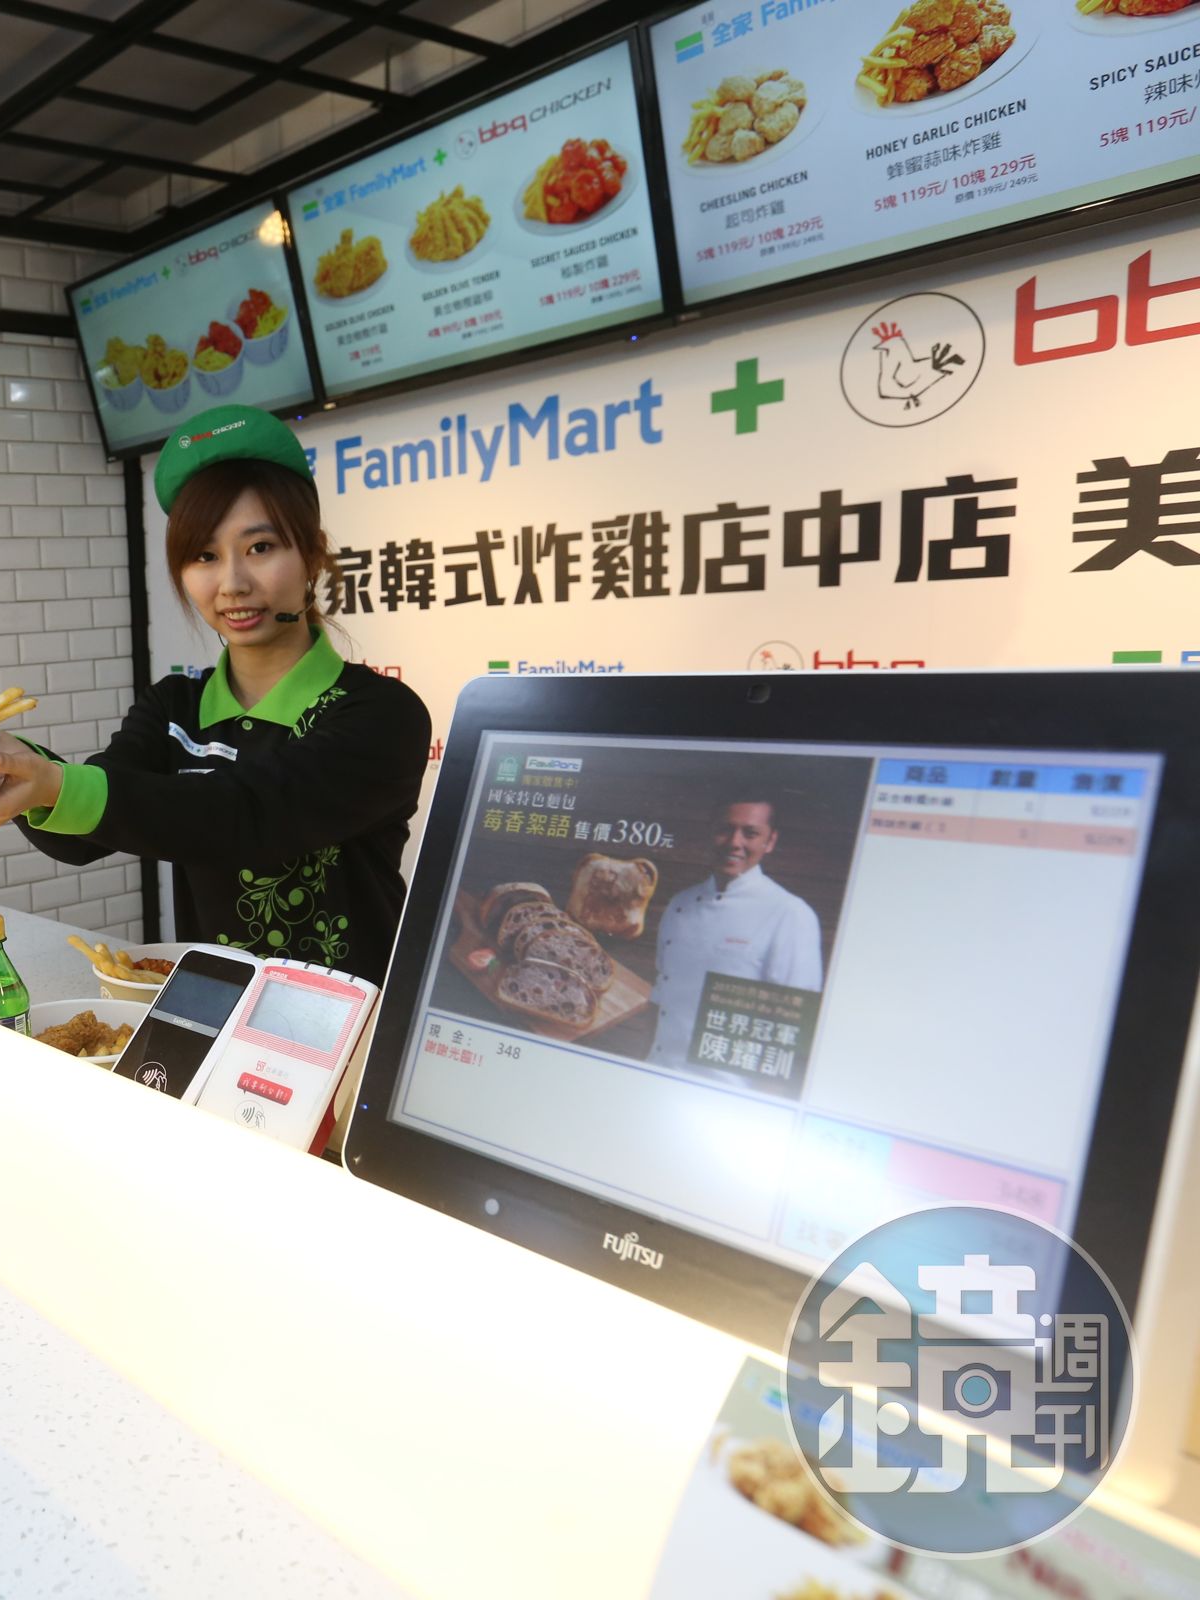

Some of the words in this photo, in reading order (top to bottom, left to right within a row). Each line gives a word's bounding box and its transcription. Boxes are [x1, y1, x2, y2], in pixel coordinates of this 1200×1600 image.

[711, 11, 753, 48] 全家
[1089, 64, 1138, 91] SPICY
[350, 157, 427, 200] FamilyMart
[529, 77, 612, 122] CHICKEN
[866, 136, 908, 160] HONEY
[912, 121, 960, 145] GARLIC
[964, 98, 1027, 129] CHICKEN
[1099, 127, 1129, 148] 5塊
[1136, 106, 1197, 136] 119元/
[886, 131, 1003, 180] 蜂蜜蒜味炸雞
[699, 186, 757, 214] CHEESLING
[759, 170, 808, 195] CHICKEN
[874, 195, 899, 212] 5塊
[953, 169, 987, 189] 10塊
[991, 153, 1037, 179] 229元
[598, 226, 639, 247] CHICKEN
[335, 379, 663, 494] FamilyMart
[1070, 446, 1200, 574] 美
[705, 1009, 801, 1045] 世界冠軍
[496, 1042, 521, 1061] 348
[697, 1031, 796, 1080] 陳耀訓
[603, 1231, 664, 1270] FUJITSU
